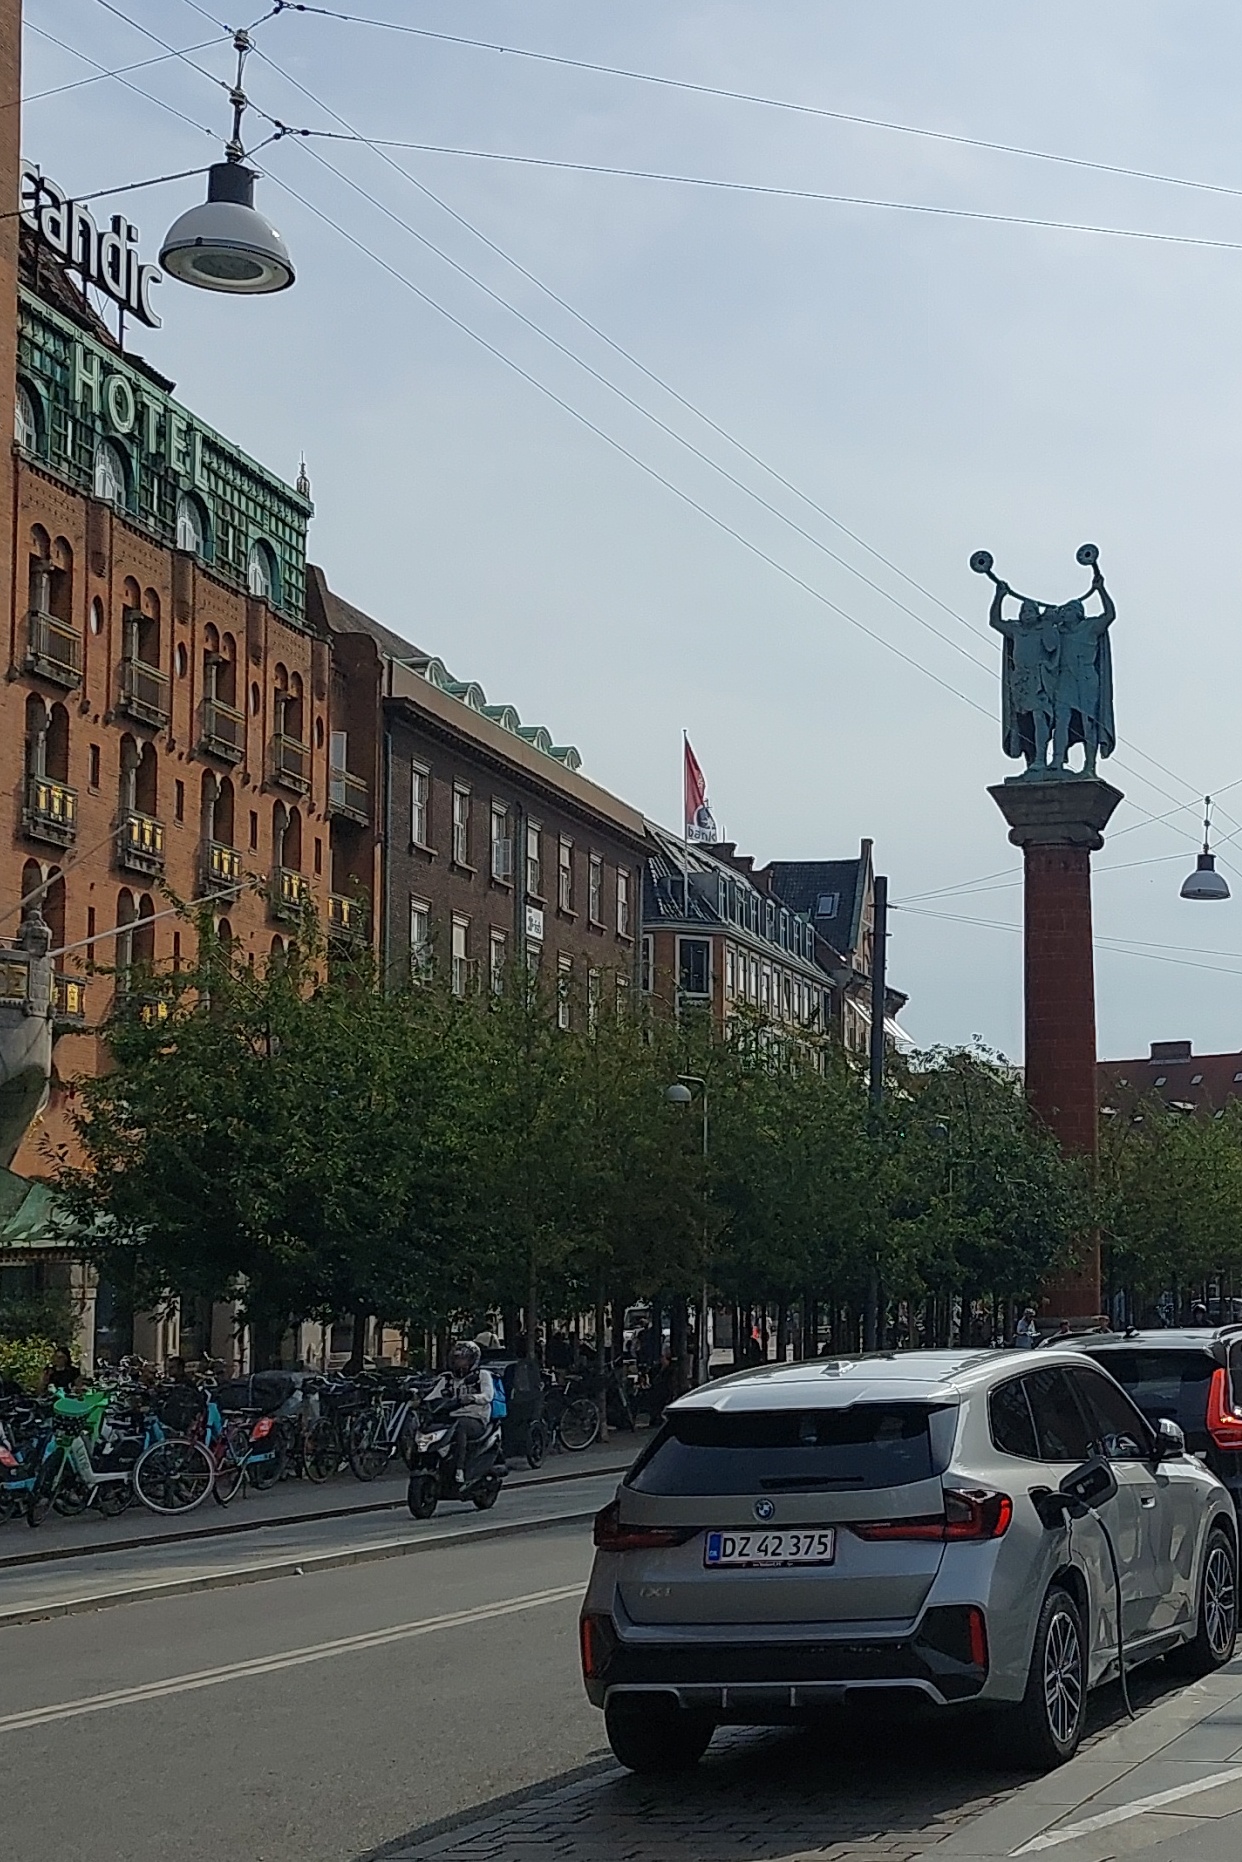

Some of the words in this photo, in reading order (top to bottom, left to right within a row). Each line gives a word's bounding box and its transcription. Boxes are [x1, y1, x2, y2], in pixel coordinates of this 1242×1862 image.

[70, 341, 210, 491] HOTEL
[721, 1536, 752, 1558] DZ
[757, 1535, 783, 1557] 42
[788, 1533, 830, 1556] 375
